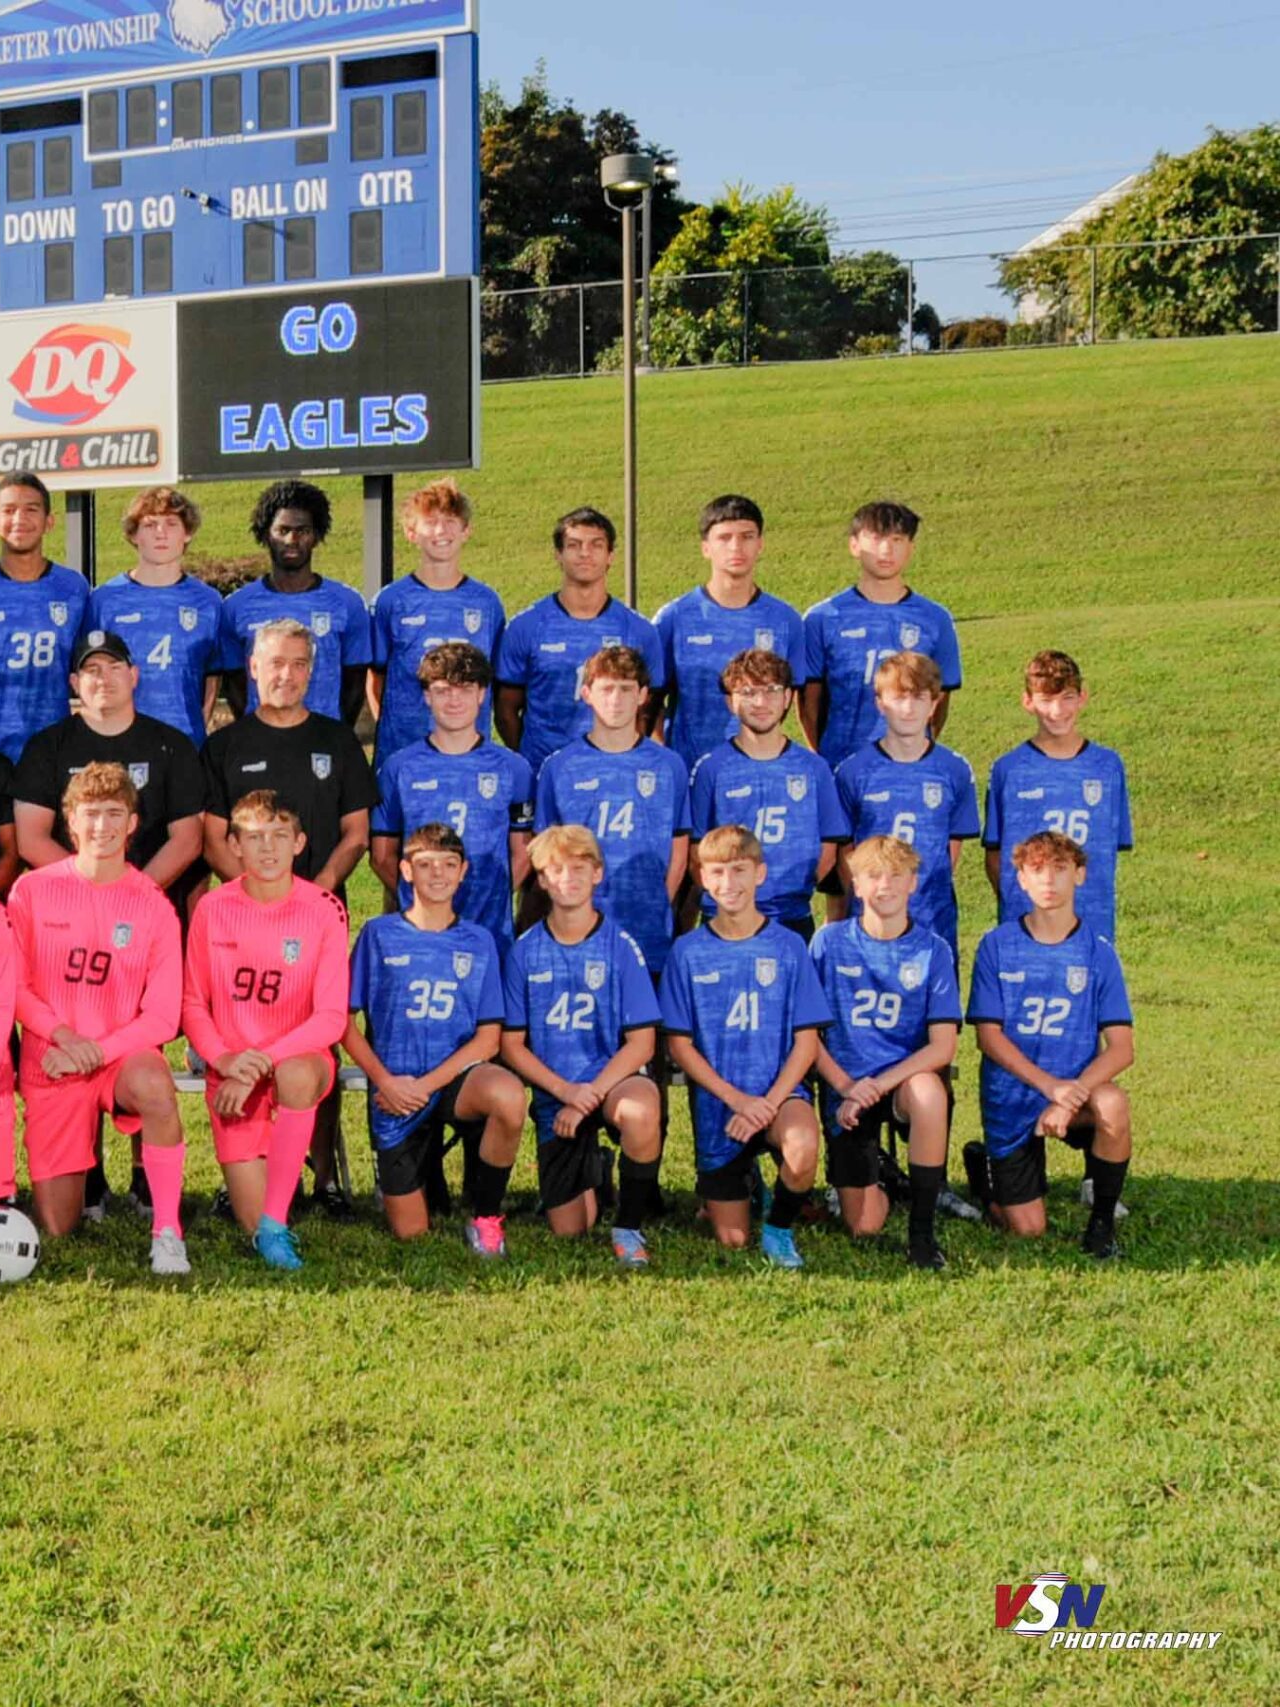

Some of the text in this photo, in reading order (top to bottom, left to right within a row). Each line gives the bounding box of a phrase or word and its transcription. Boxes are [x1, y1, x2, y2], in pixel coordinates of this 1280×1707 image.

[242, 0, 341, 28] SCHOOL
[54, 12, 161, 55] TOWNSHIP
[231, 178, 328, 219] BALL ON
[359, 169, 413, 206] QTR
[4, 206, 76, 245] DOWN
[102, 195, 176, 233] TO GO
[280, 302, 357, 355] GO
[26, 343, 121, 401] DQ
[219, 394, 428, 453] EAGLES
[7, 631, 56, 668] 38
[147, 634, 173, 670] 4
[864, 649, 898, 684] 1
[448, 801, 468, 837] 3
[597, 801, 634, 838] 14
[755, 807, 787, 843] 15
[892, 812, 916, 844] 6
[1042, 810, 1090, 846] 36
[64, 948, 111, 986] 99
[232, 967, 282, 1004] 98
[406, 981, 458, 1020] 35
[546, 992, 595, 1031] 42
[726, 991, 759, 1031] 41
[851, 990, 901, 1028] 29
[1018, 997, 1070, 1035] 32
